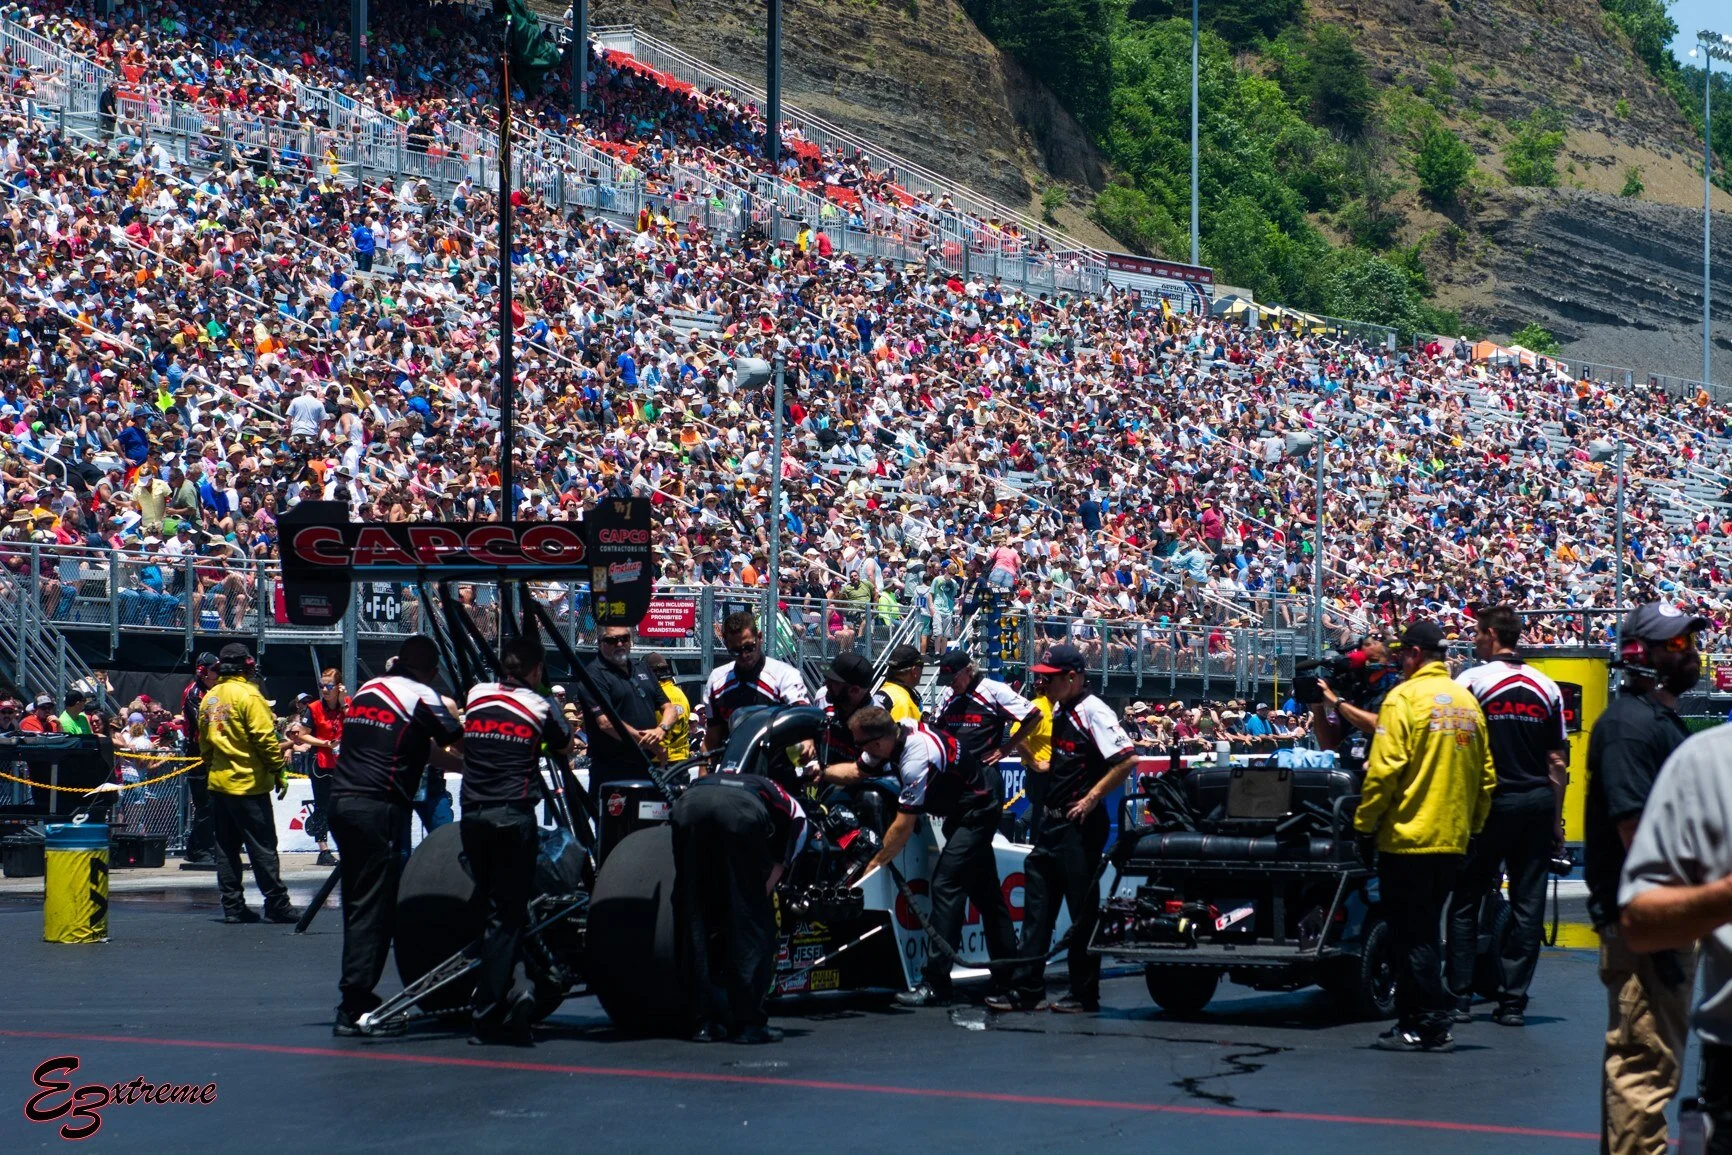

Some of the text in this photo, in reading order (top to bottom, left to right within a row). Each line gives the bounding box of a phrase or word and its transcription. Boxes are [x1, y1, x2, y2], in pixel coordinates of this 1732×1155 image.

[599, 528, 650, 544] CAPCO
[292, 525, 586, 566] CAPCO
[599, 545, 648, 553] CONTRACTORS INC
[343, 717, 374, 726] TRACTORS
[347, 704, 398, 725] APCO
[463, 731, 511, 742] ONTRACTORS
[794, 945, 825, 962] JESEL
